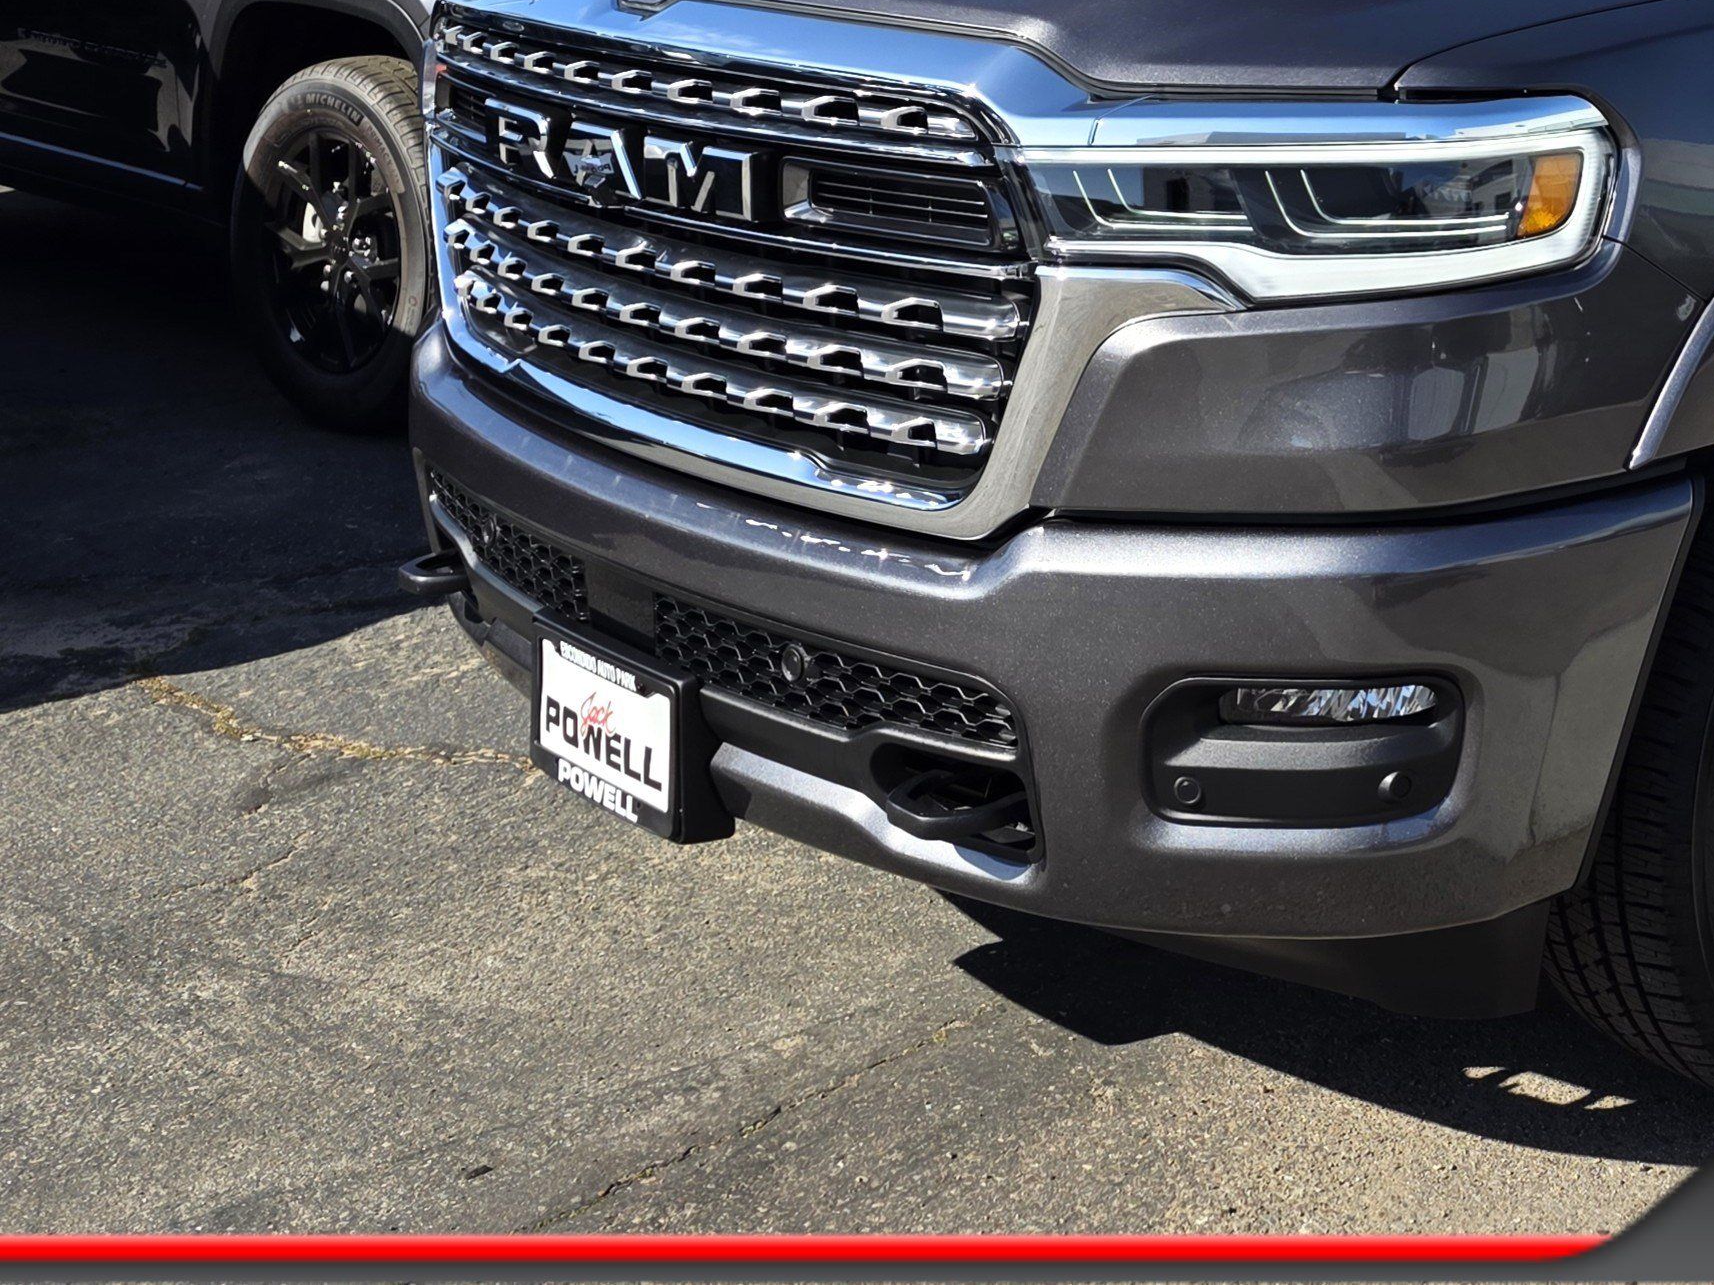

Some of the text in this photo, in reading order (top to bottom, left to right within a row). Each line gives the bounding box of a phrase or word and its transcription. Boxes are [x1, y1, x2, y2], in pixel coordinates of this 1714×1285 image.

[305, 93, 361, 123] MICHELIN
[484, 97, 770, 222] RAM
[545, 695, 663, 792] POWELL
[580, 691, 617, 738] Jack
[557, 758, 639, 823] POWELL
